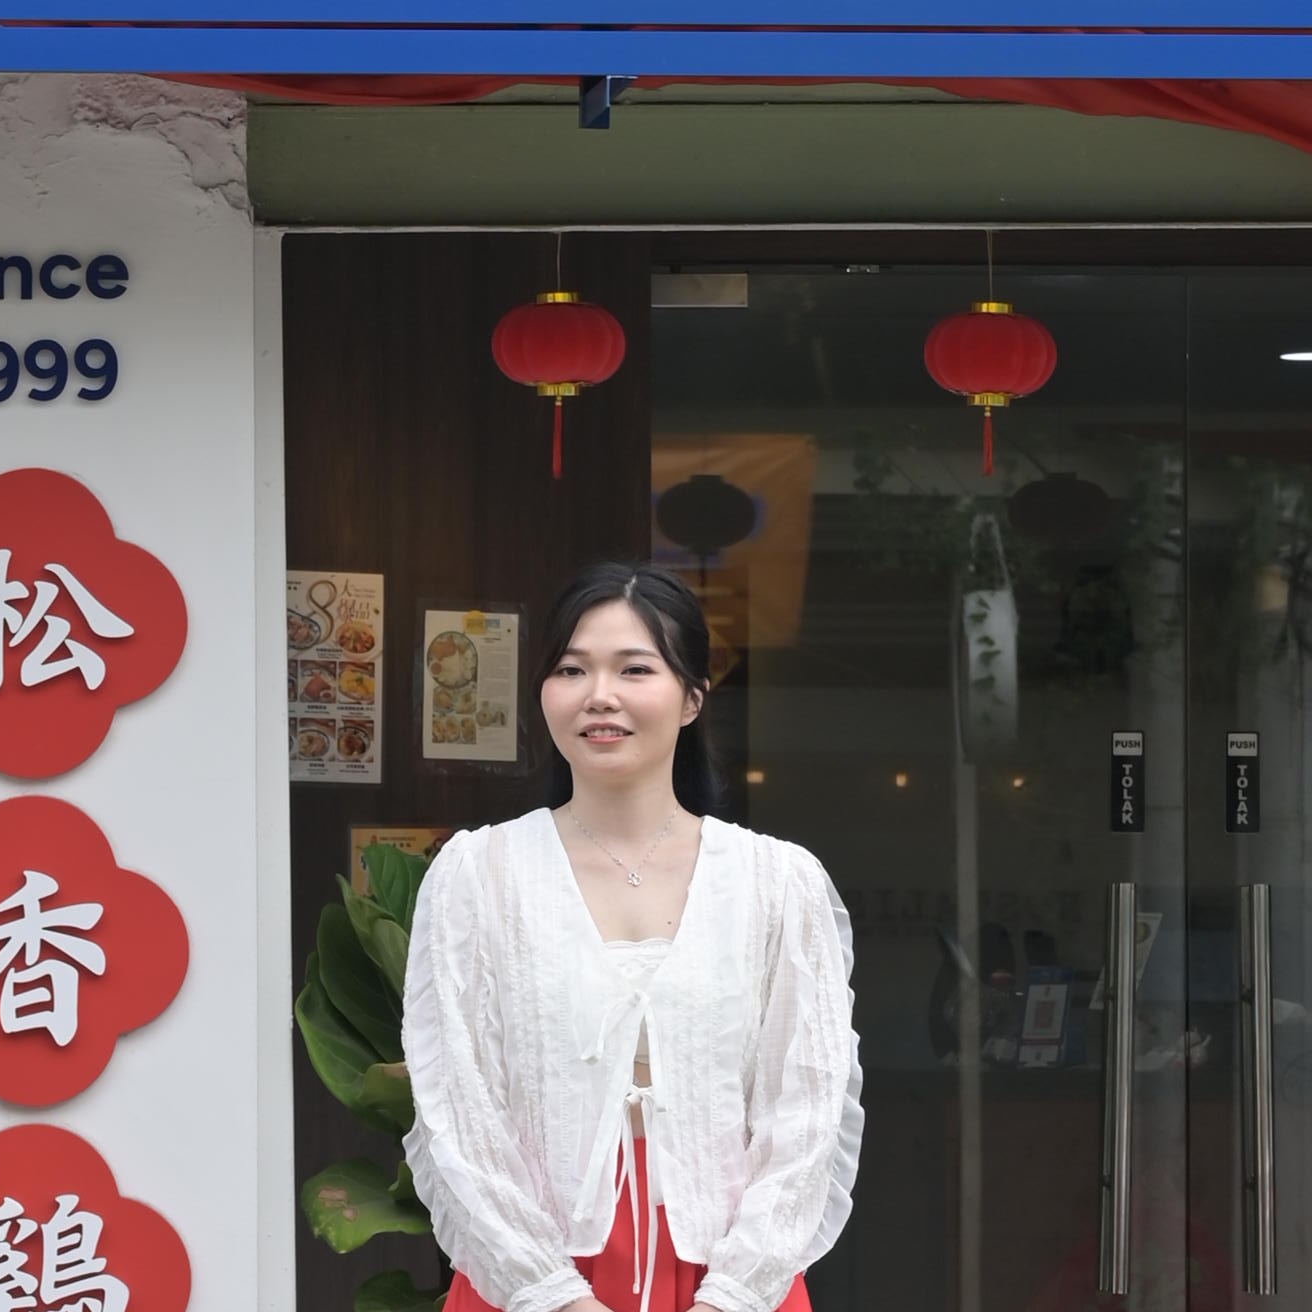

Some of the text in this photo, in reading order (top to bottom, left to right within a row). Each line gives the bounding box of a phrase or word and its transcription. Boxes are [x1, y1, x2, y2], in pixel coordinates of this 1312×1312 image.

[1114, 740, 1141, 749] PUSH
[1229, 740, 1256, 750] PUSH
[1121, 764, 1134, 825] TOLAK
[1236, 765, 1249, 825] TOLAK
